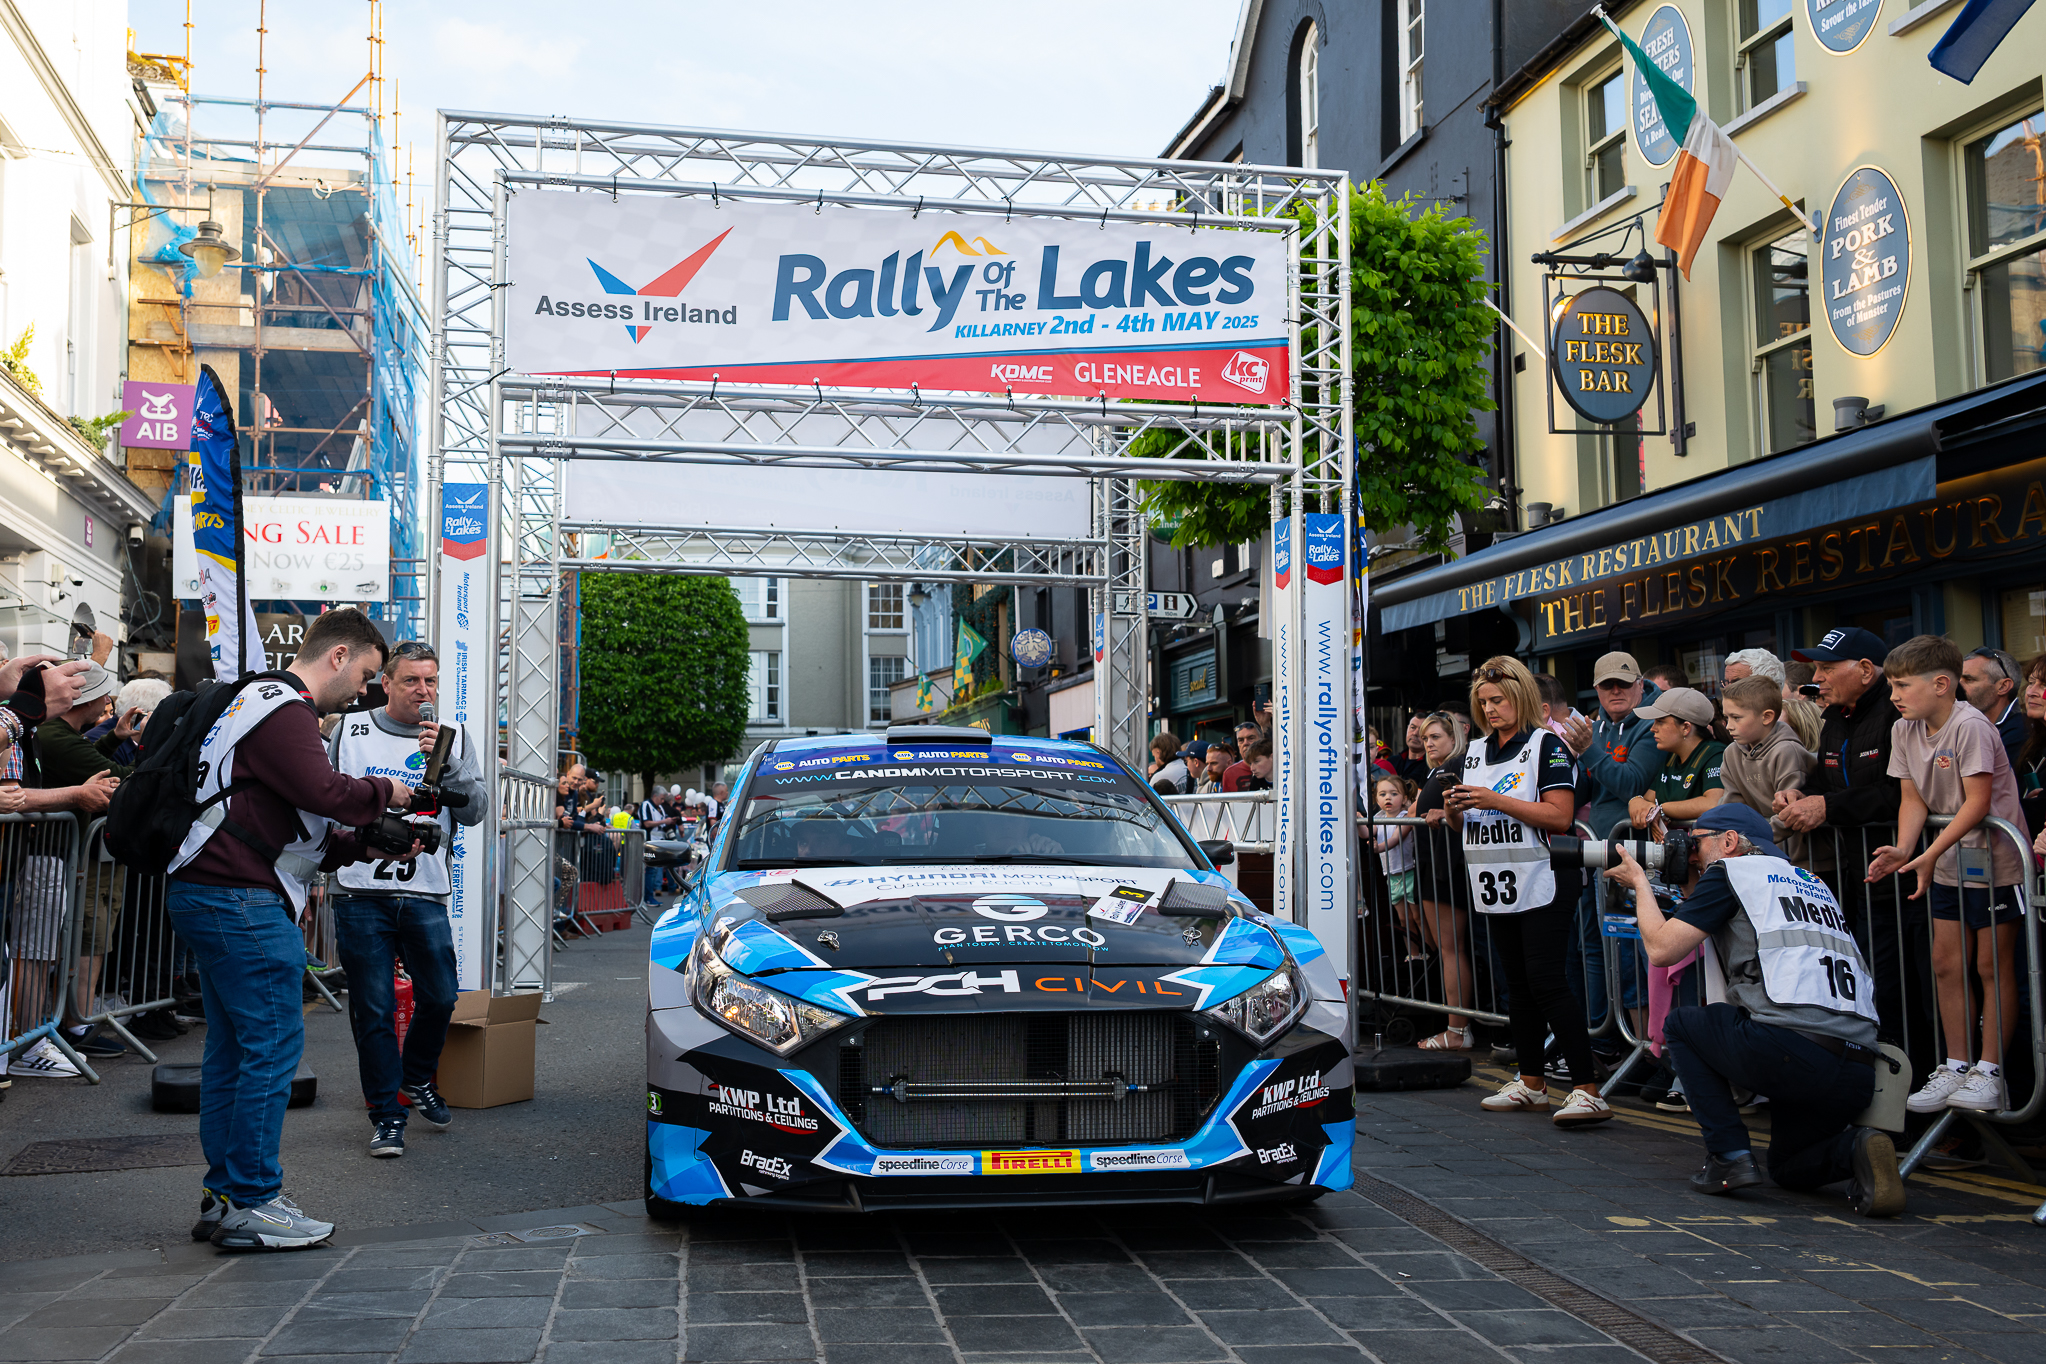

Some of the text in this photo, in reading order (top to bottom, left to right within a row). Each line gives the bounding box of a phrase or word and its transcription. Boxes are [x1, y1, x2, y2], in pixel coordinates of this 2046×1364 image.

[1821, 9, 1845, 33] Savour
[1845, 2, 1858, 18] the
[1644, 27, 1675, 57] FRESH
[1671, 67, 1684, 82] Our
[1644, 125, 1665, 148] A Real
[1834, 197, 1888, 232] Finest Tender
[1830, 213, 1895, 260] PORK
[1851, 248, 1879, 270] &
[771, 241, 1256, 333] Rally Of The Lakes
[1831, 255, 1899, 300] LAMB
[534, 295, 737, 325] Assess Ireland
[1832, 284, 1901, 321] from the Pastures
[954, 321, 1048, 338] KILLARNEY
[1049, 313, 1096, 335] 2nd
[1116, 312, 1155, 333] 4th
[1161, 311, 1221, 332] MAY
[1222, 315, 1260, 330] 2025
[1577, 312, 1630, 337] THE
[1846, 303, 1889, 328] of Munster
[1565, 340, 1645, 366] FLESK
[990, 363, 1054, 382] KDMC
[1074, 361, 1202, 388] GLENEAGLE
[1239, 374, 1264, 385] print
[1579, 369, 1633, 394] BAR
[136, 421, 178, 442] AIB
[270, 504, 309, 515] CELTIC
[315, 505, 381, 518] JEWELLERY
[445, 516, 473, 528] Rally
[450, 525, 482, 536] Lakes
[324, 552, 365, 571] €25
[1308, 544, 1332, 555] Rally
[1312, 553, 1339, 563] Lakes
[1458, 506, 1764, 611] THE FLESK RESTAURANT
[1541, 480, 2046, 637] THE FLESK RESTAURA
[460, 652, 468, 672] IRISH
[460, 674, 468, 705] TARMAC
[350, 723, 370, 737] 25
[798, 757, 830, 767] AUTO
[832, 754, 871, 764] PARTS
[918, 751, 949, 759] AUTO
[951, 751, 989, 759] PARTS
[1035, 755, 1066, 765] AUTO
[1066, 758, 1105, 769] PARTS
[1279, 623, 1290, 911] www.rallyofthelakes.com
[1314, 620, 1338, 911] www.rallyofthelakes.com
[1464, 756, 1480, 770] 33
[365, 766, 424, 781] Motorspo
[1466, 819, 1524, 845] Media
[373, 858, 417, 882] 25
[868, 872, 1138, 885] HYUNDAI MOTORSPORT
[452, 863, 464, 913] KERRY RALLY
[877, 879, 1053, 891] Customer Racing
[1478, 870, 1518, 906] 33
[1767, 874, 1829, 896] Motorsport
[1795, 886, 1832, 904] Ireland
[1778, 896, 1850, 935] Media
[933, 925, 1106, 947] GERCO
[937, 942, 963, 951] PLAN
[1050, 941, 1109, 952] TOMORROW
[457, 926, 465, 982] STELLANTIS
[868, 970, 1183, 1001] PCH CIVIL
[1818, 955, 1857, 1001] 16
[719, 1085, 760, 1109] KWP
[1251, 1086, 1330, 1120] PARTITIONS & CEILINGS
[1262, 1079, 1296, 1106] KWP
[709, 1101, 819, 1130] PARTITIONS & CEILINGS
[740, 1149, 793, 1177] BradEx
[991, 1151, 1073, 1170] PIRELLI
[1257, 1142, 1297, 1165] BradEx
